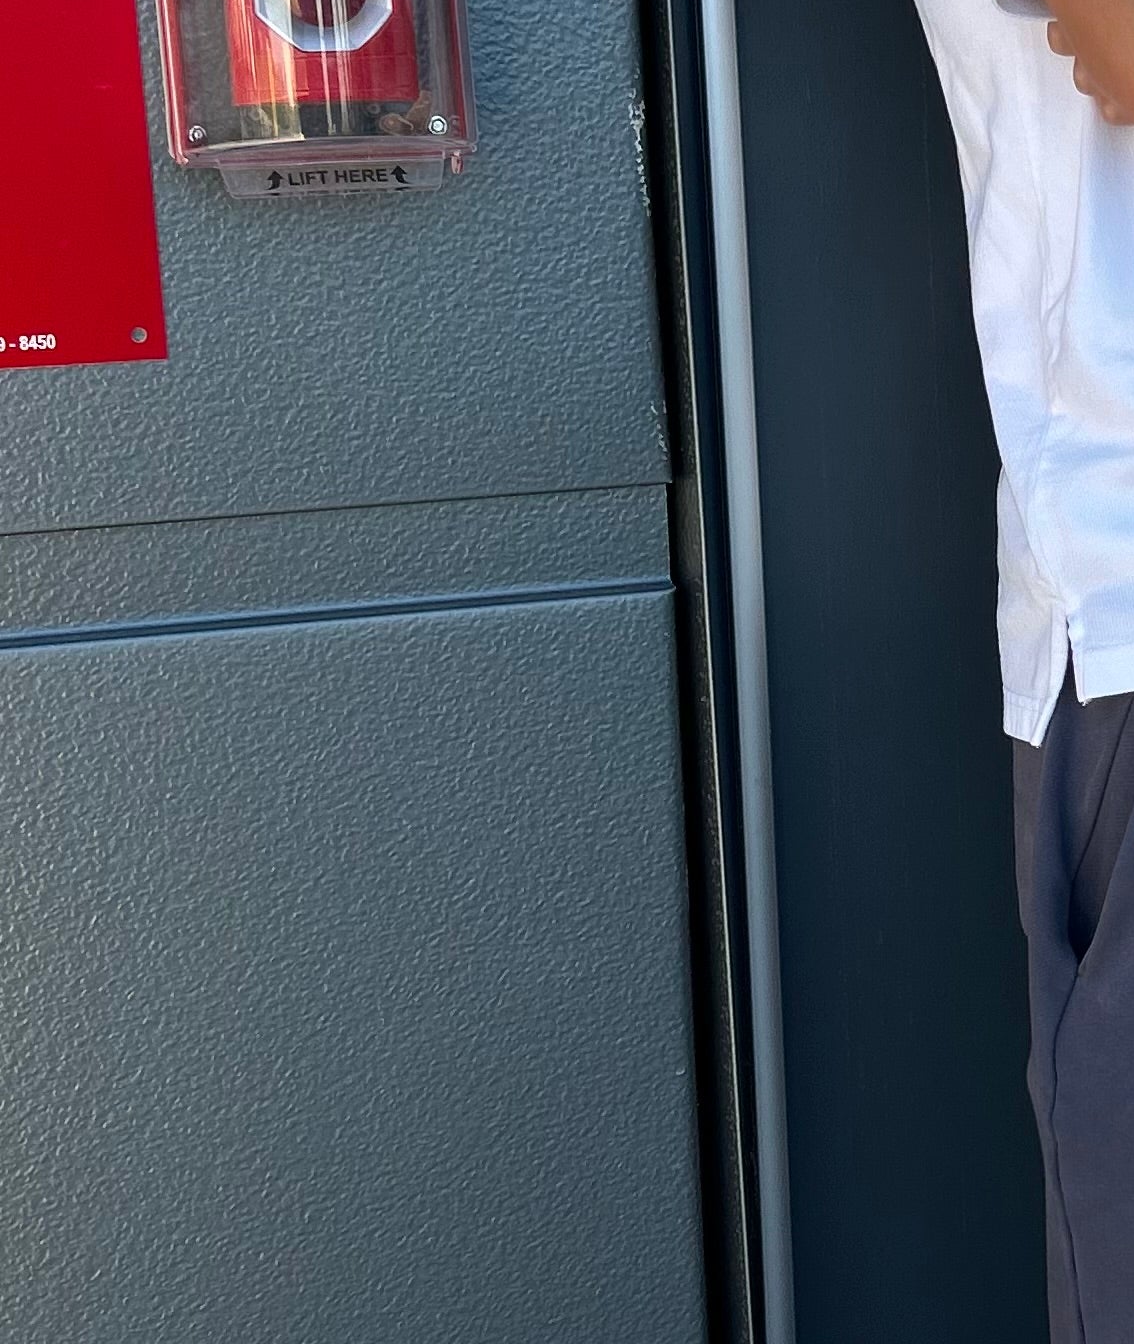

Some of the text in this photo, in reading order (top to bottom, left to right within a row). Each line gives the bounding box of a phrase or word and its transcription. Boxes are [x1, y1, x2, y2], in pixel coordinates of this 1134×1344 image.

[288, 168, 388, 186] LIFT HERE
[19, 334, 57, 351] 8450
